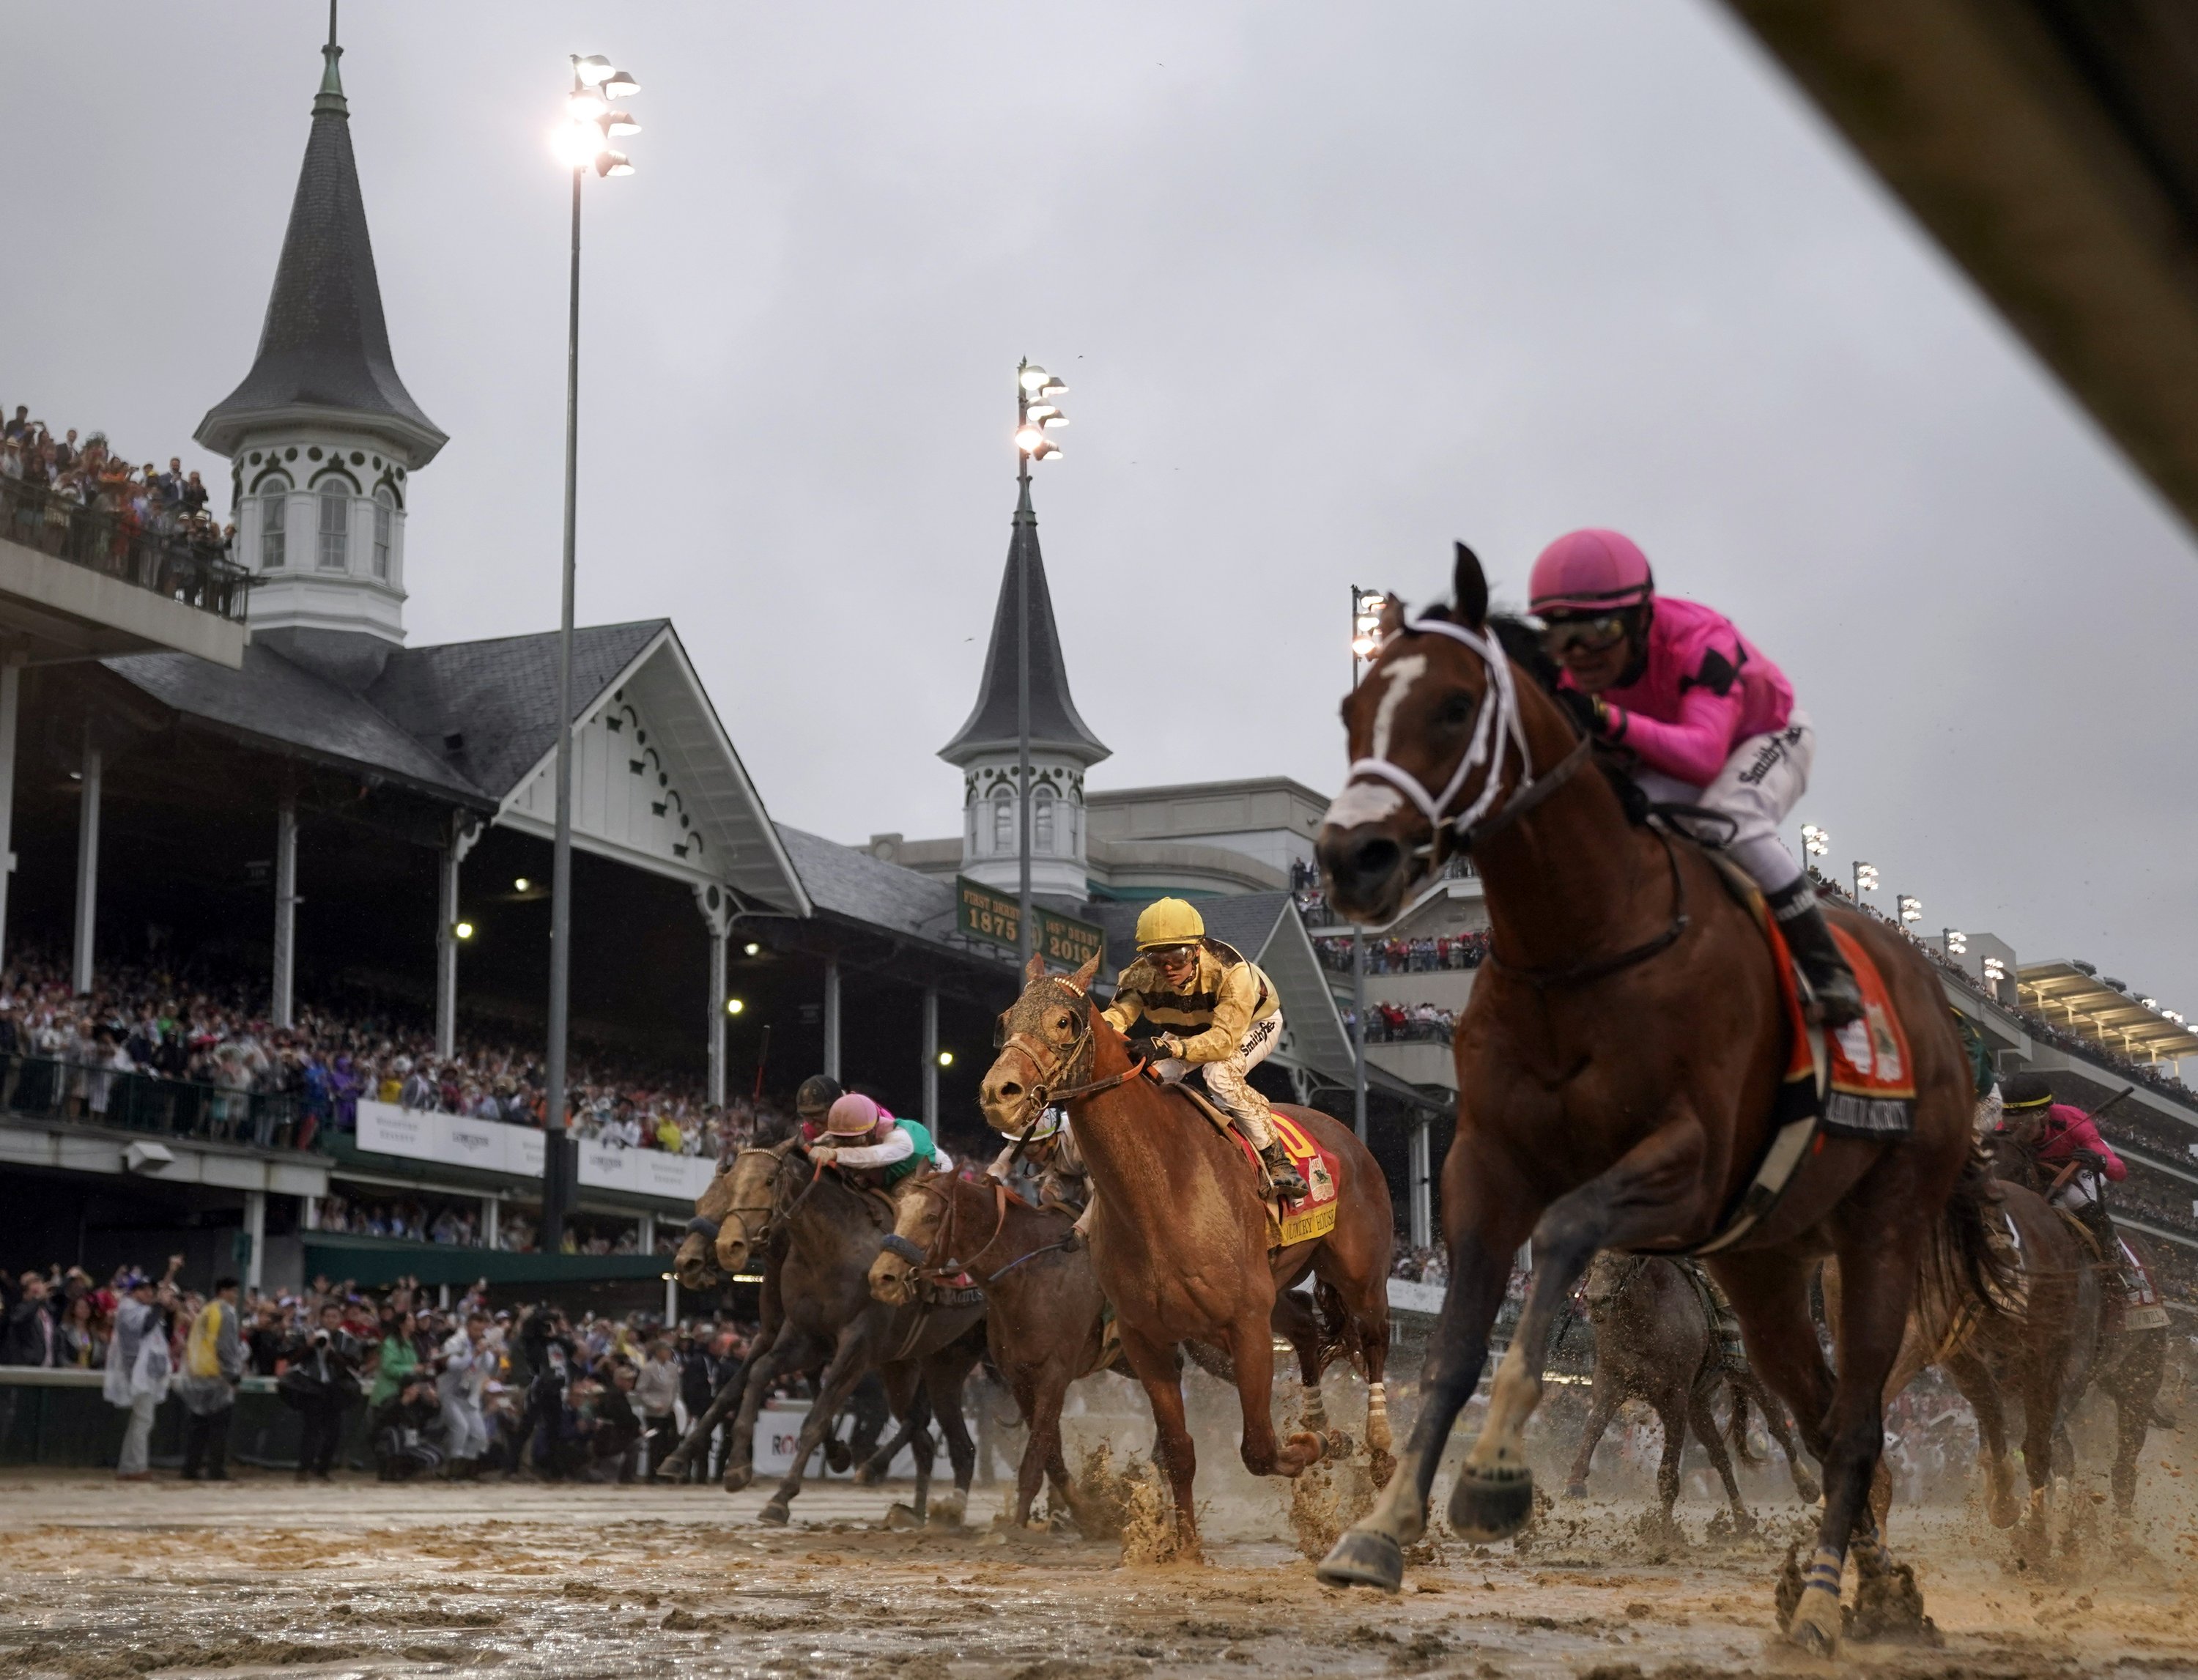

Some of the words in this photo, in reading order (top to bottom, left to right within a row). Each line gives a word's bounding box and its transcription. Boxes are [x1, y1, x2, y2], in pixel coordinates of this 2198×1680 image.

[963, 890, 991, 911] FIRST
[969, 909, 1017, 941] 1875
[1049, 936, 1092, 965] 2019
